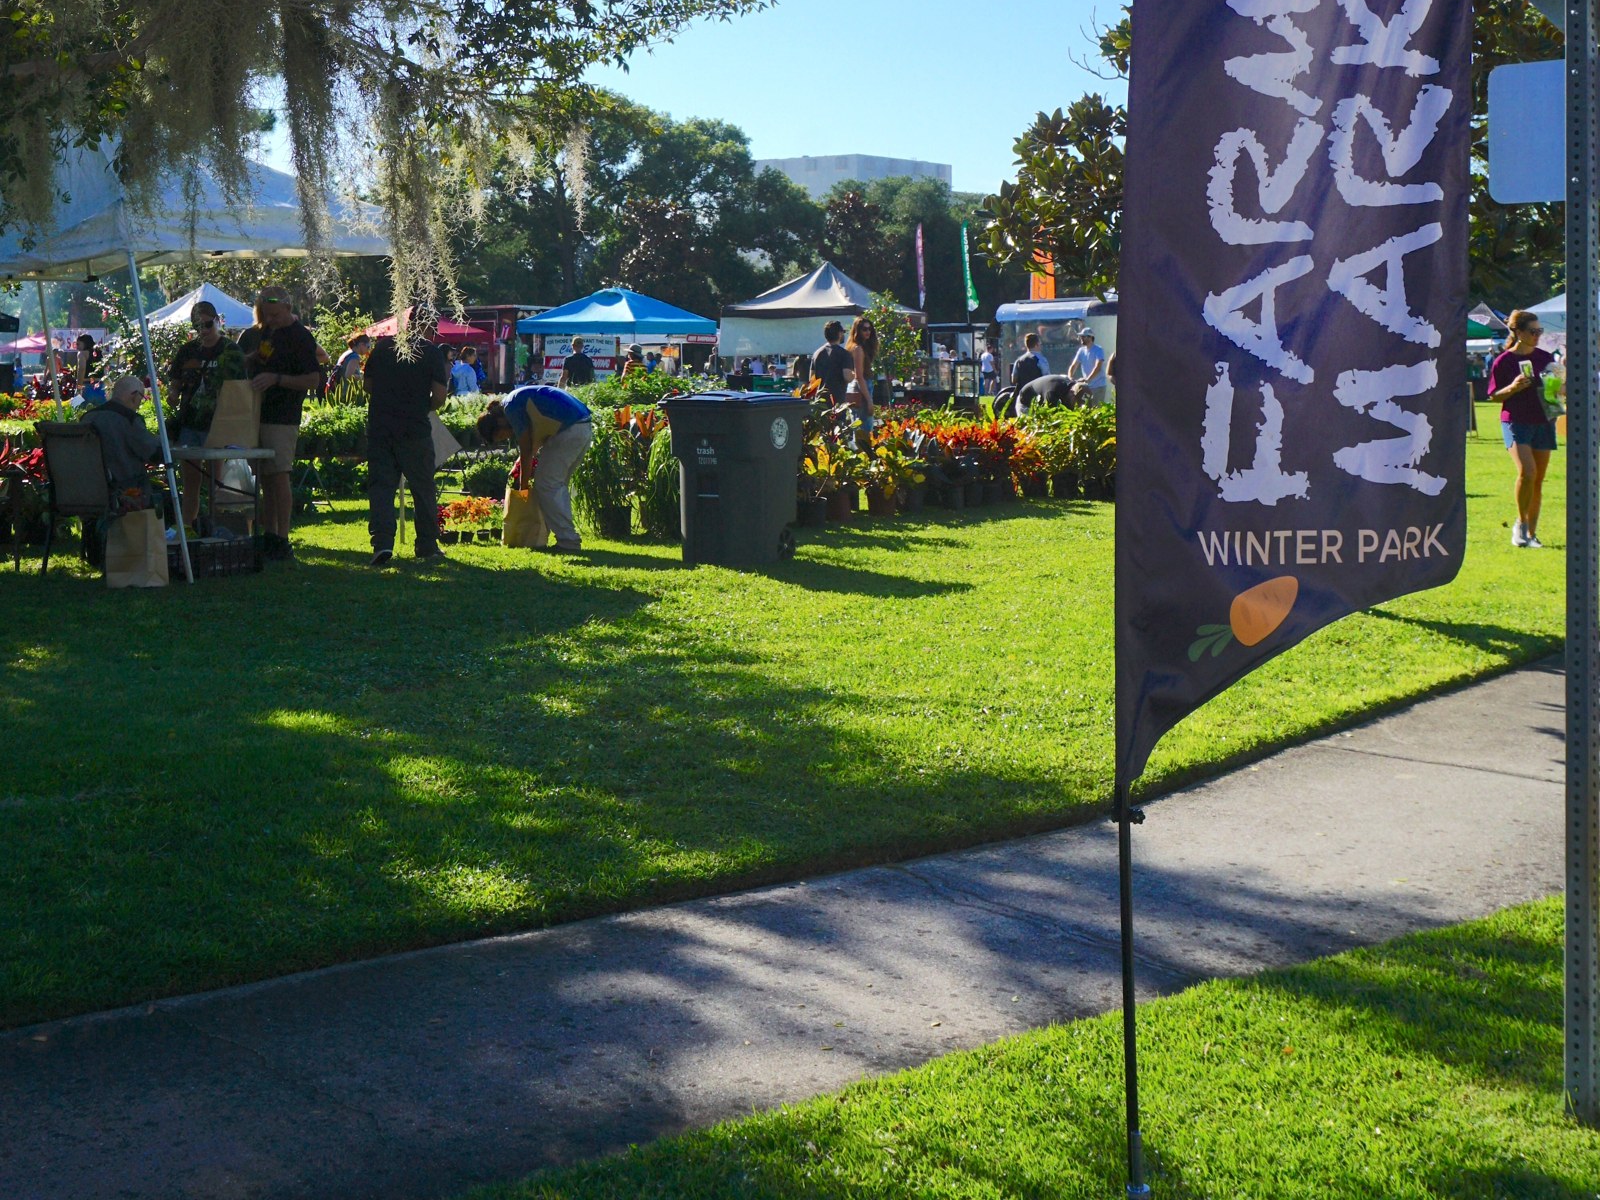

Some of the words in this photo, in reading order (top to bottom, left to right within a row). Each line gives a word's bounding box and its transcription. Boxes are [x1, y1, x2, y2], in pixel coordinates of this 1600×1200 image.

[583, 344, 602, 355] Edge
[696, 446, 715, 455] trash
[1197, 530, 1343, 566] WINTER
[1358, 523, 1449, 563] PARK
